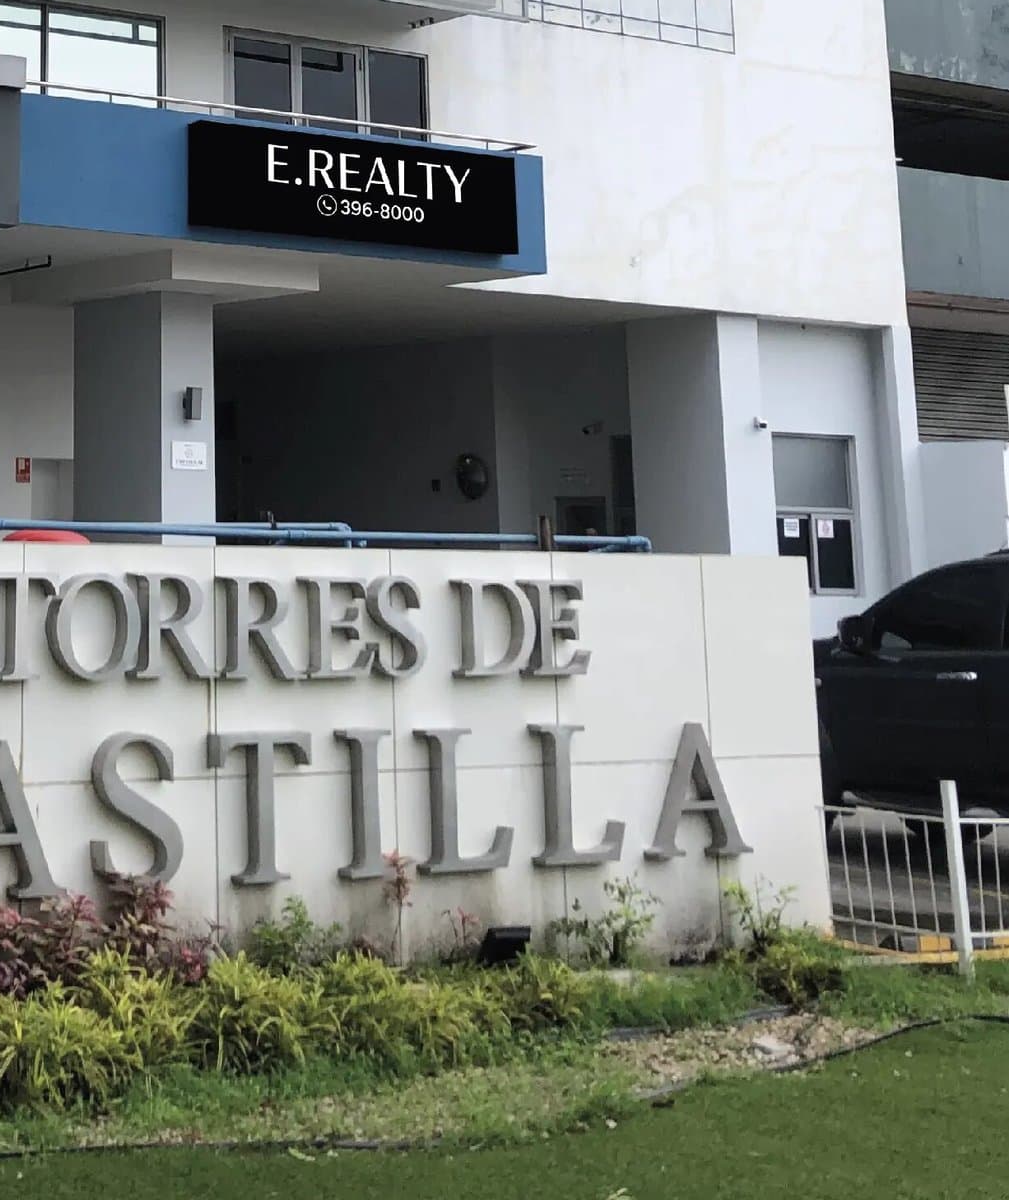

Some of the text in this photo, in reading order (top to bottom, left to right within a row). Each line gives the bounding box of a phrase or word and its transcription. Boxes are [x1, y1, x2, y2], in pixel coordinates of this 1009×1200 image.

[267, 143, 471, 204] E.REALTY
[340, 199, 425, 224] 396-8000
[449, 577, 592, 680] DE
